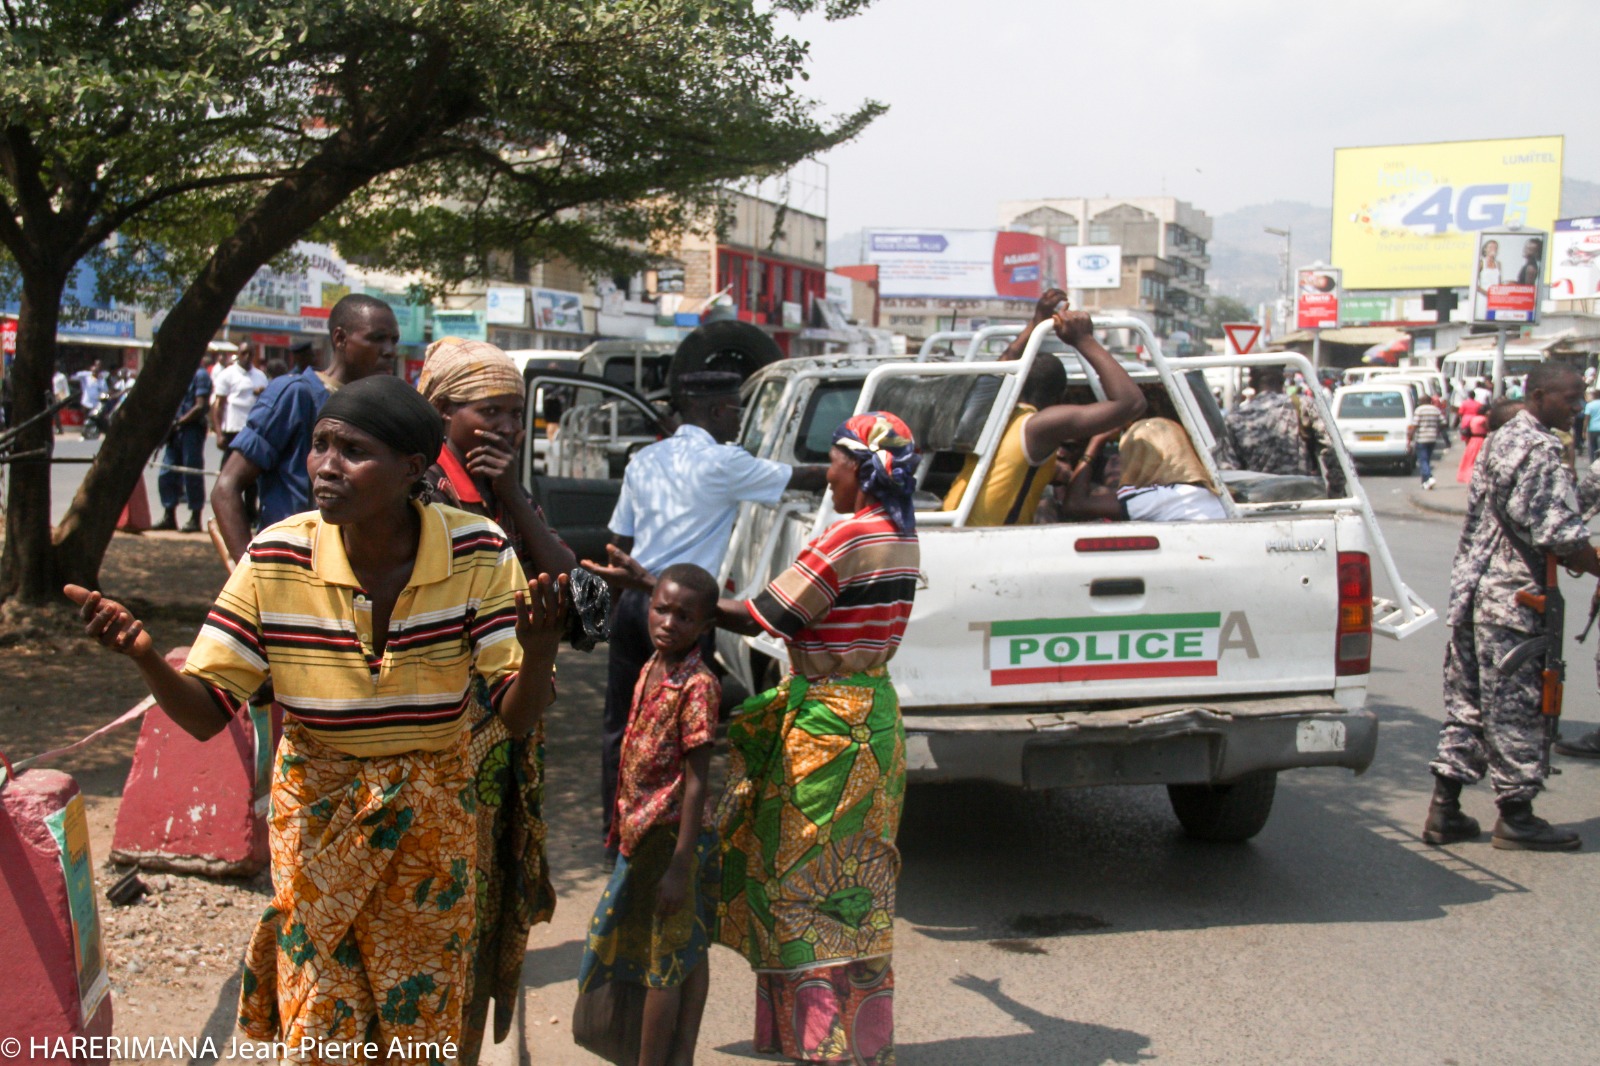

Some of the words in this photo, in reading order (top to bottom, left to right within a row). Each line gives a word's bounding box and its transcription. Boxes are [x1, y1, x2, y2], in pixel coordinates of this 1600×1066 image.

[1502, 150, 1556, 166] LUMITEL
[1377, 167, 1433, 188] hello
[1401, 183, 1510, 234] 4G
[1009, 630, 1204, 665] POLICE
